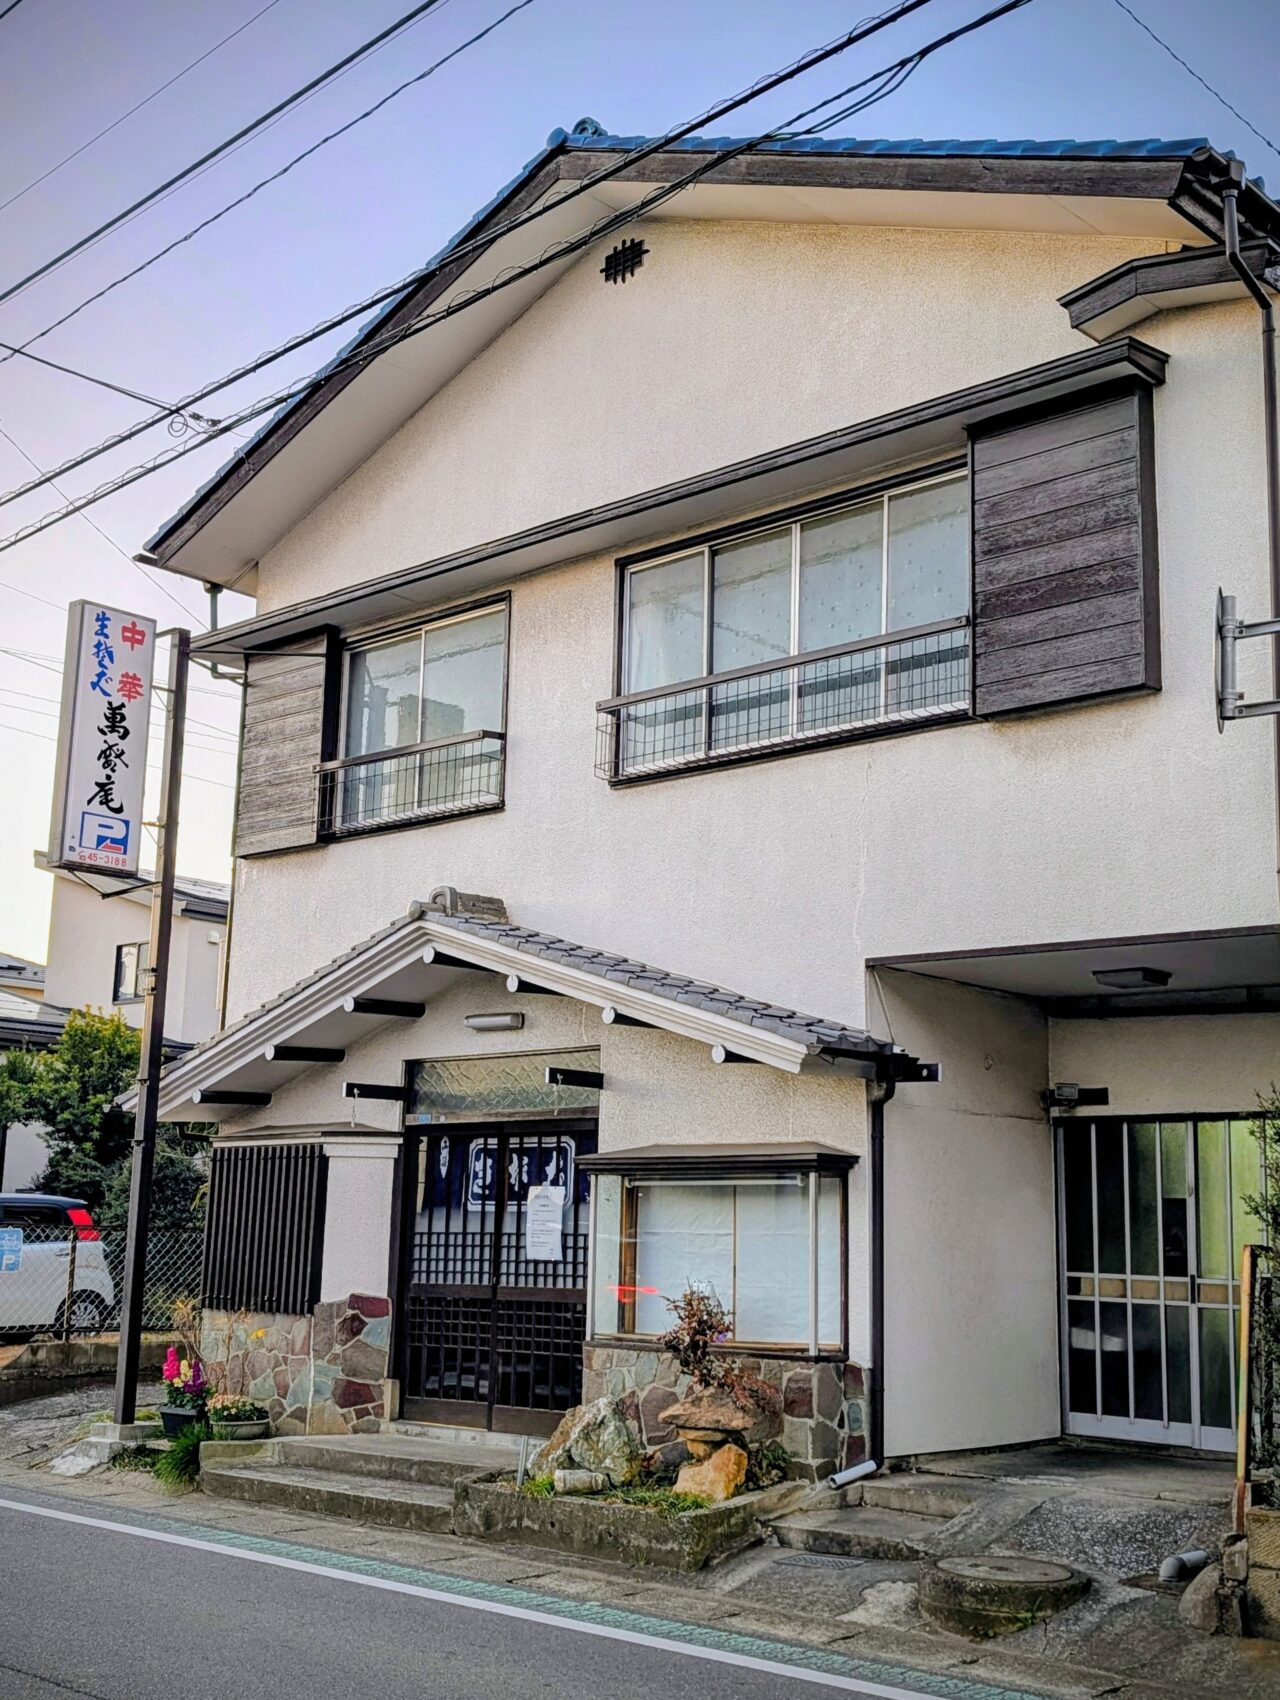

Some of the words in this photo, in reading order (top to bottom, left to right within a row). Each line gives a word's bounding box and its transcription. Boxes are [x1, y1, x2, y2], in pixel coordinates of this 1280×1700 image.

[117, 621, 146, 703] 中華
[82, 813, 126, 850] P
[88, 852, 127, 867] 45-3188
[2, 1255, 15, 1270] P
